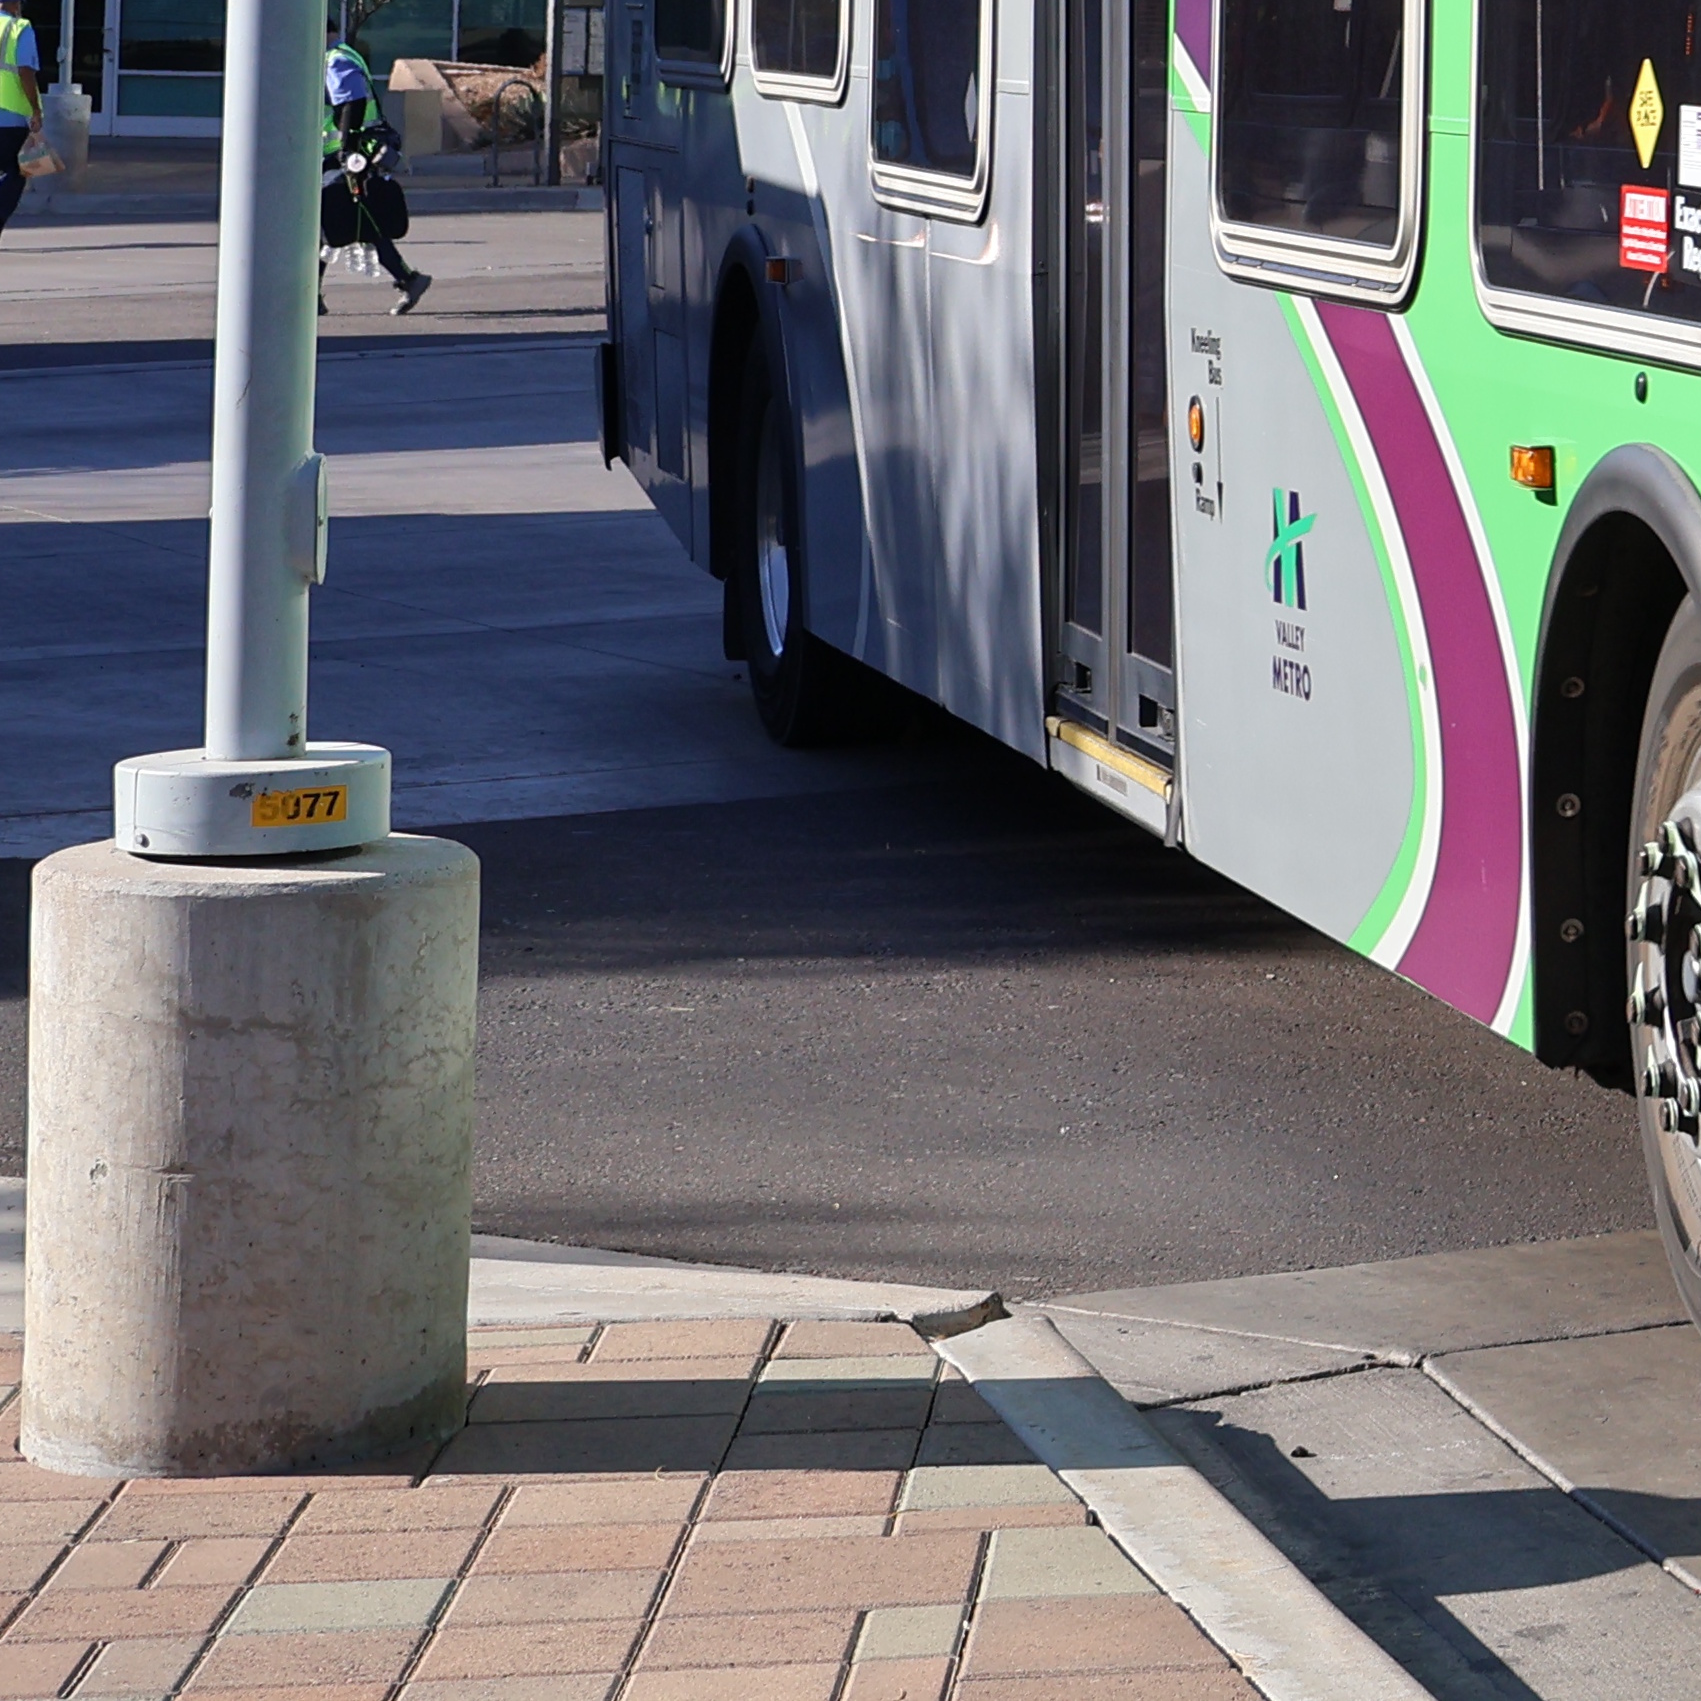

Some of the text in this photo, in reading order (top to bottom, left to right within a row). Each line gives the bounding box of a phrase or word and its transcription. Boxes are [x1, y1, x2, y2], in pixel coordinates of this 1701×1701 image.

[1190, 327, 1222, 361] Kneeling
[1208, 360, 1223, 386] Bus
[1196, 488, 1215, 520] Ramp
[1274, 619, 1305, 652] VALLEY
[1272, 655, 1312, 701] METRO
